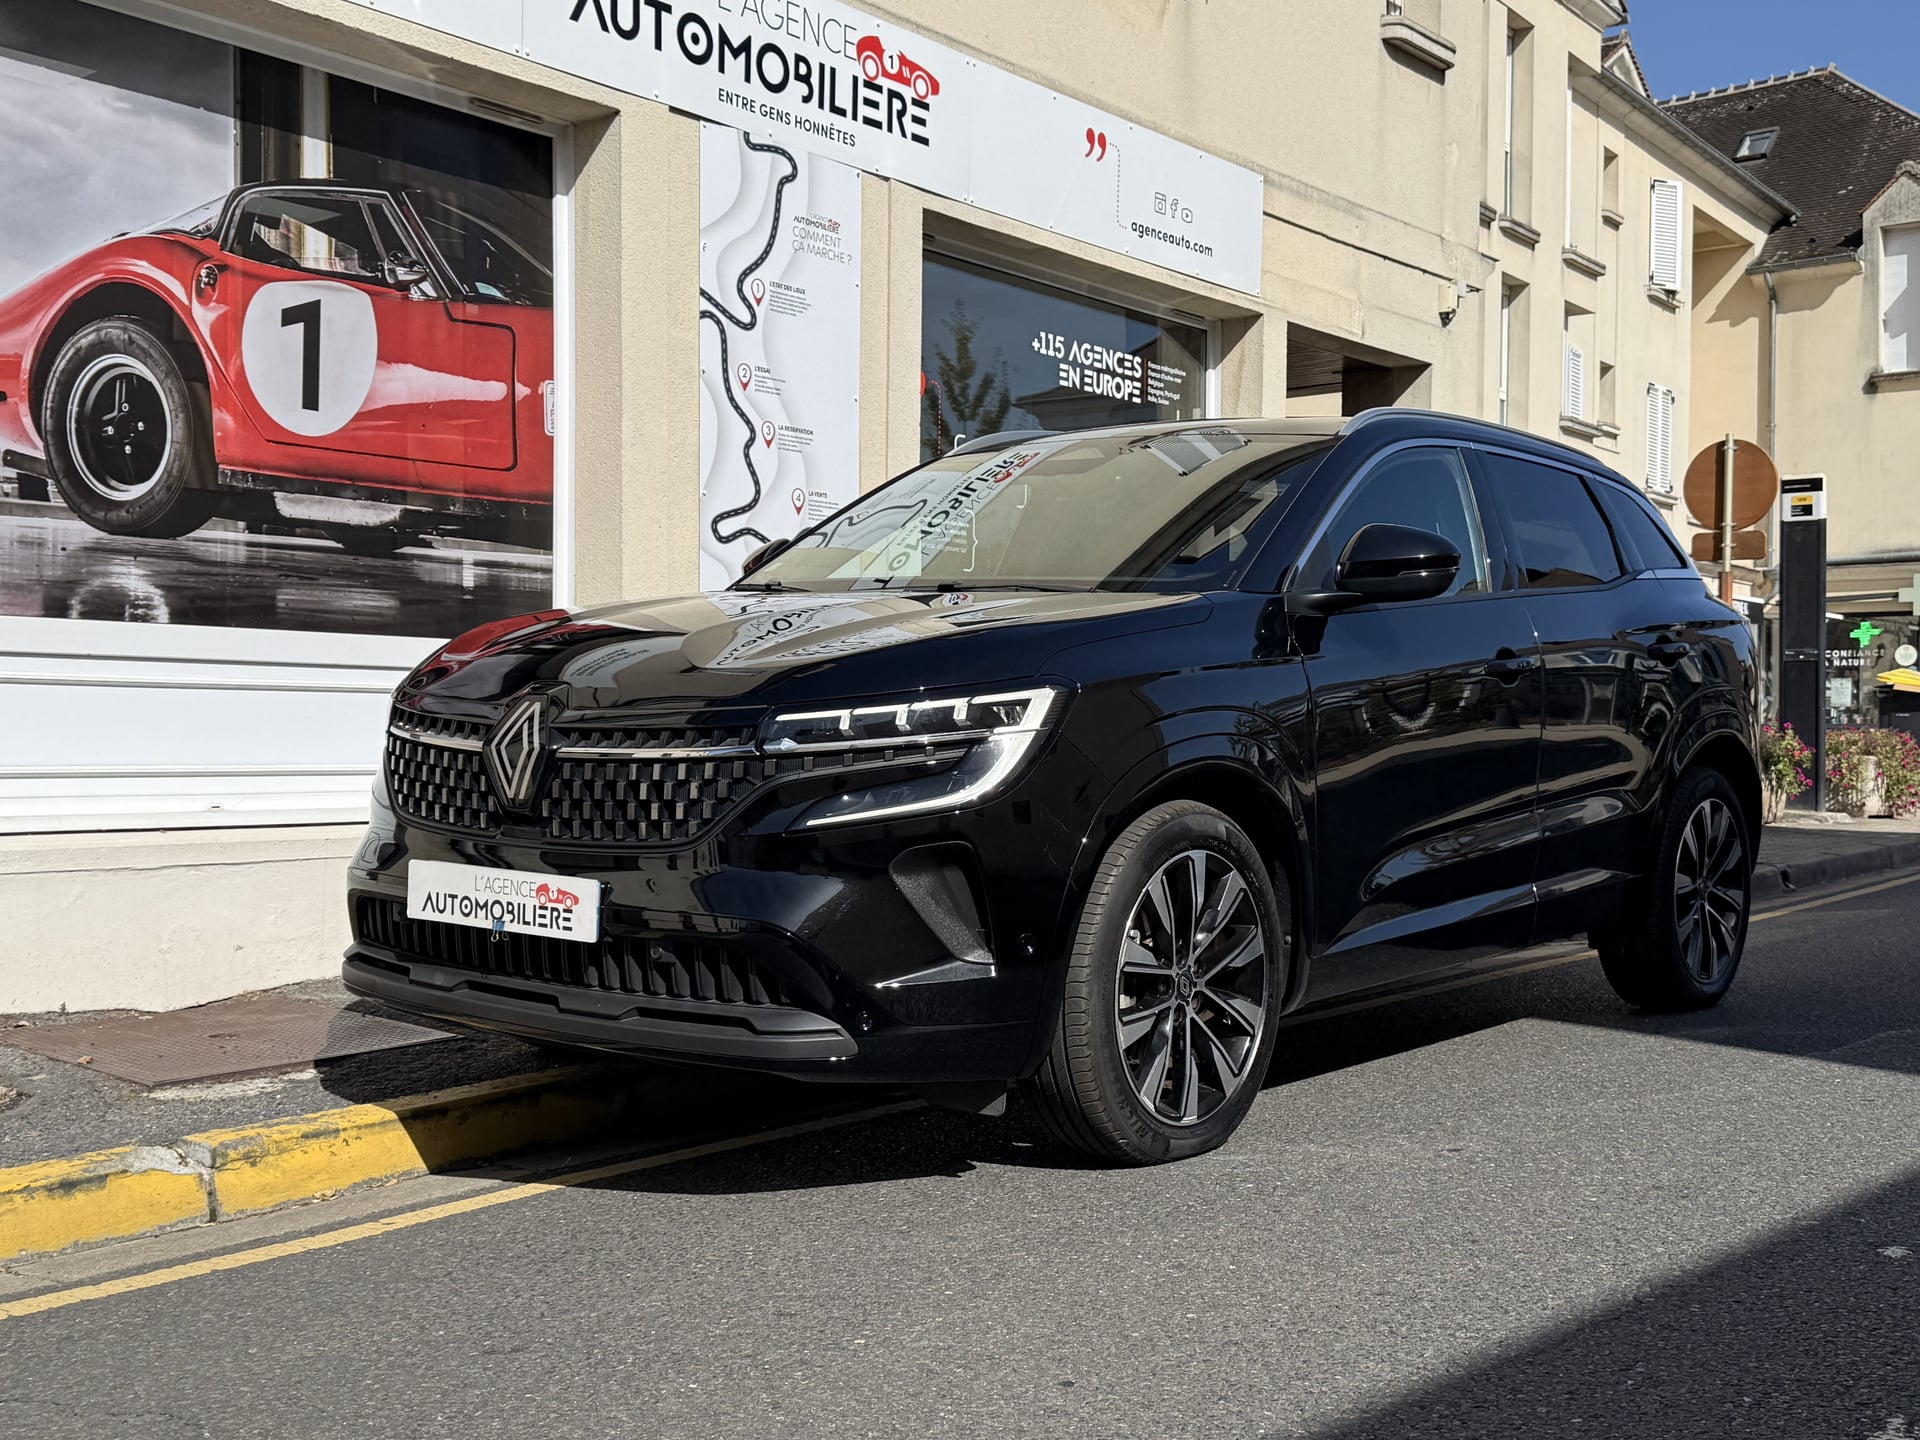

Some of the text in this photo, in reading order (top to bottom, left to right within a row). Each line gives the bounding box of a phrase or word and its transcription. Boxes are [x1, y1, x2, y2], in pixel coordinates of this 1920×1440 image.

[718, 88, 856, 147] ENTRE GENS HONNÊTES
[792, 226, 842, 249] COMMENT
[792, 240, 805, 253] ÇA
[807, 243, 846, 264] MARCHE
[1131, 221, 1213, 257] agenceauto.com
[280, 300, 321, 412] 1
[1032, 331, 1142, 378] +115 AGENCES
[741, 368, 748, 379] 2
[1059, 363, 1141, 404] EN EUROPE
[765, 425, 772, 436] 3
[795, 493, 802, 503] 4
[474, 874, 537, 899] L'AGENCE
[421, 890, 574, 932] AUTOMOBILIERE
